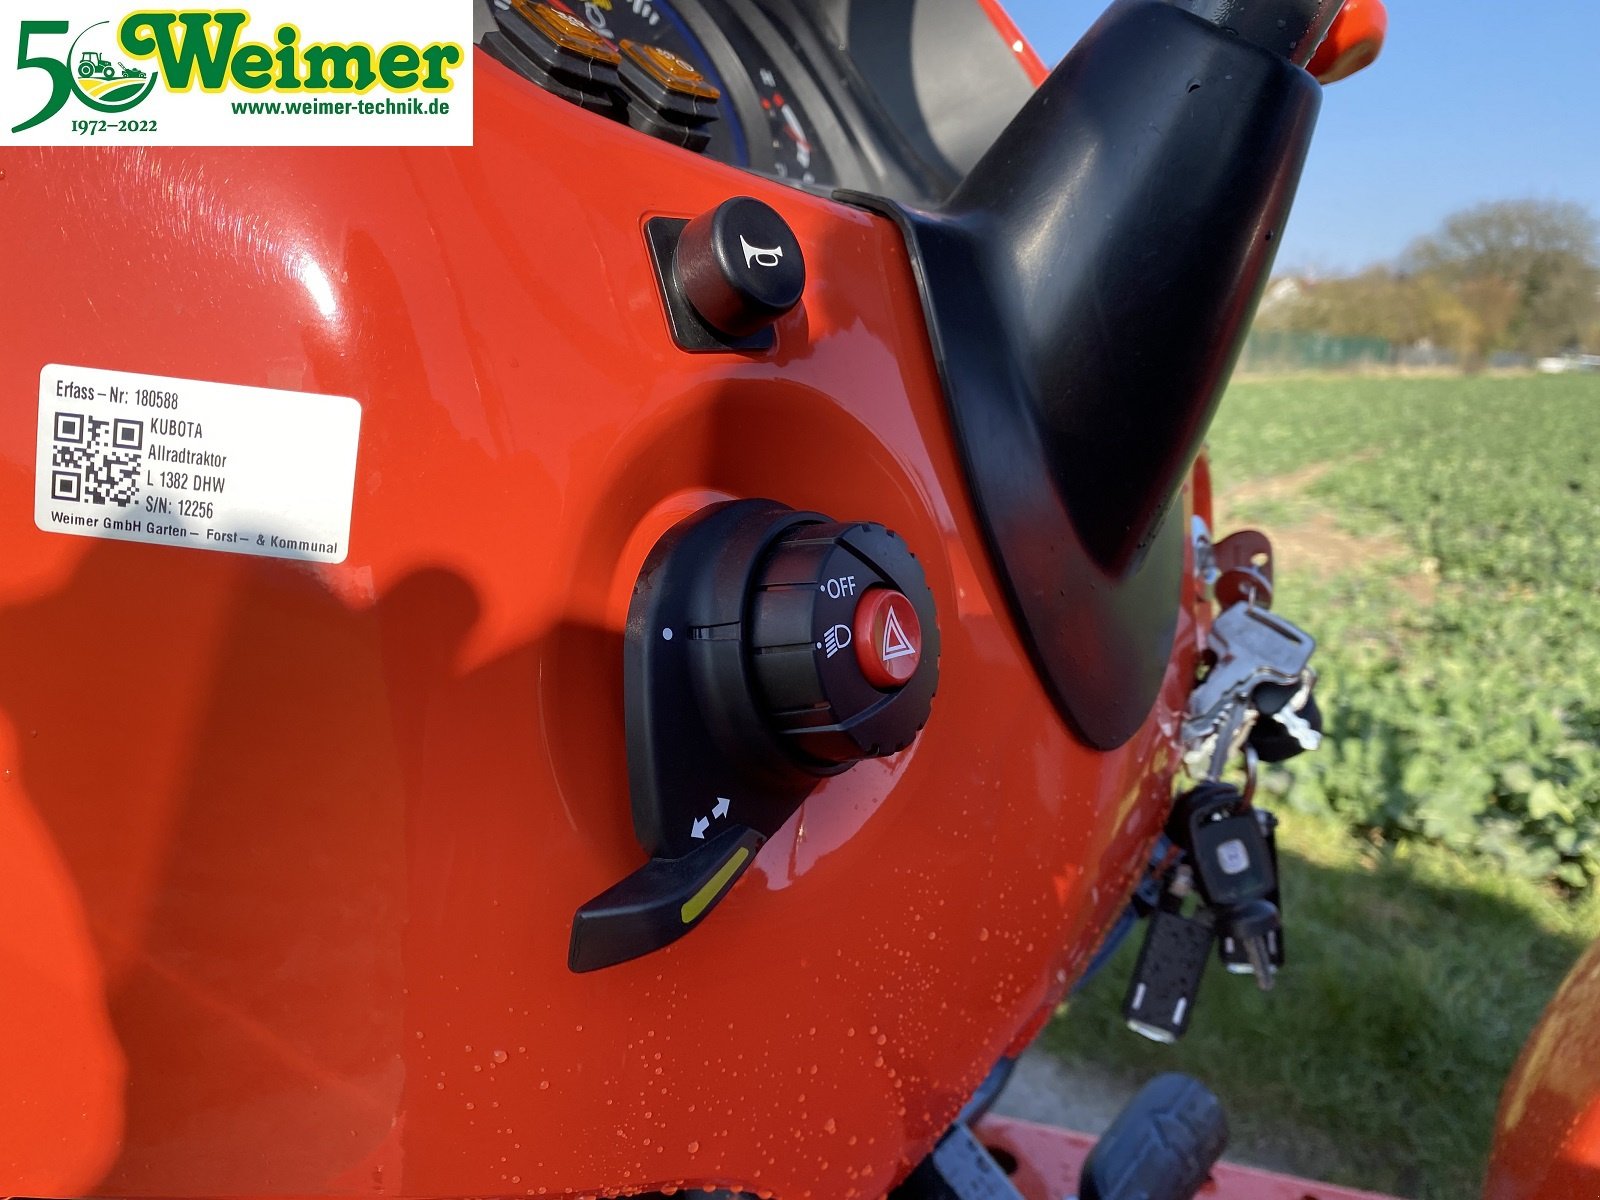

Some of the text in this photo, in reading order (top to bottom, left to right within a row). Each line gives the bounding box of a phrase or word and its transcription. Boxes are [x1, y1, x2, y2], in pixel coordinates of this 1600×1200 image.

[135, 390, 180, 410] 180588
[150, 418, 203, 438] KUBOTA
[148, 444, 227, 468] Allradtraktor
[147, 471, 225, 494] L 1382 DHW
[146, 497, 213, 519] S/N: 12256
[51, 511, 98, 527] Weimer
[103, 518, 141, 533] GmbH
[256, 534, 265, 546] &
[270, 536, 338, 554] Kommunal
[827, 576, 855, 599] OFF
